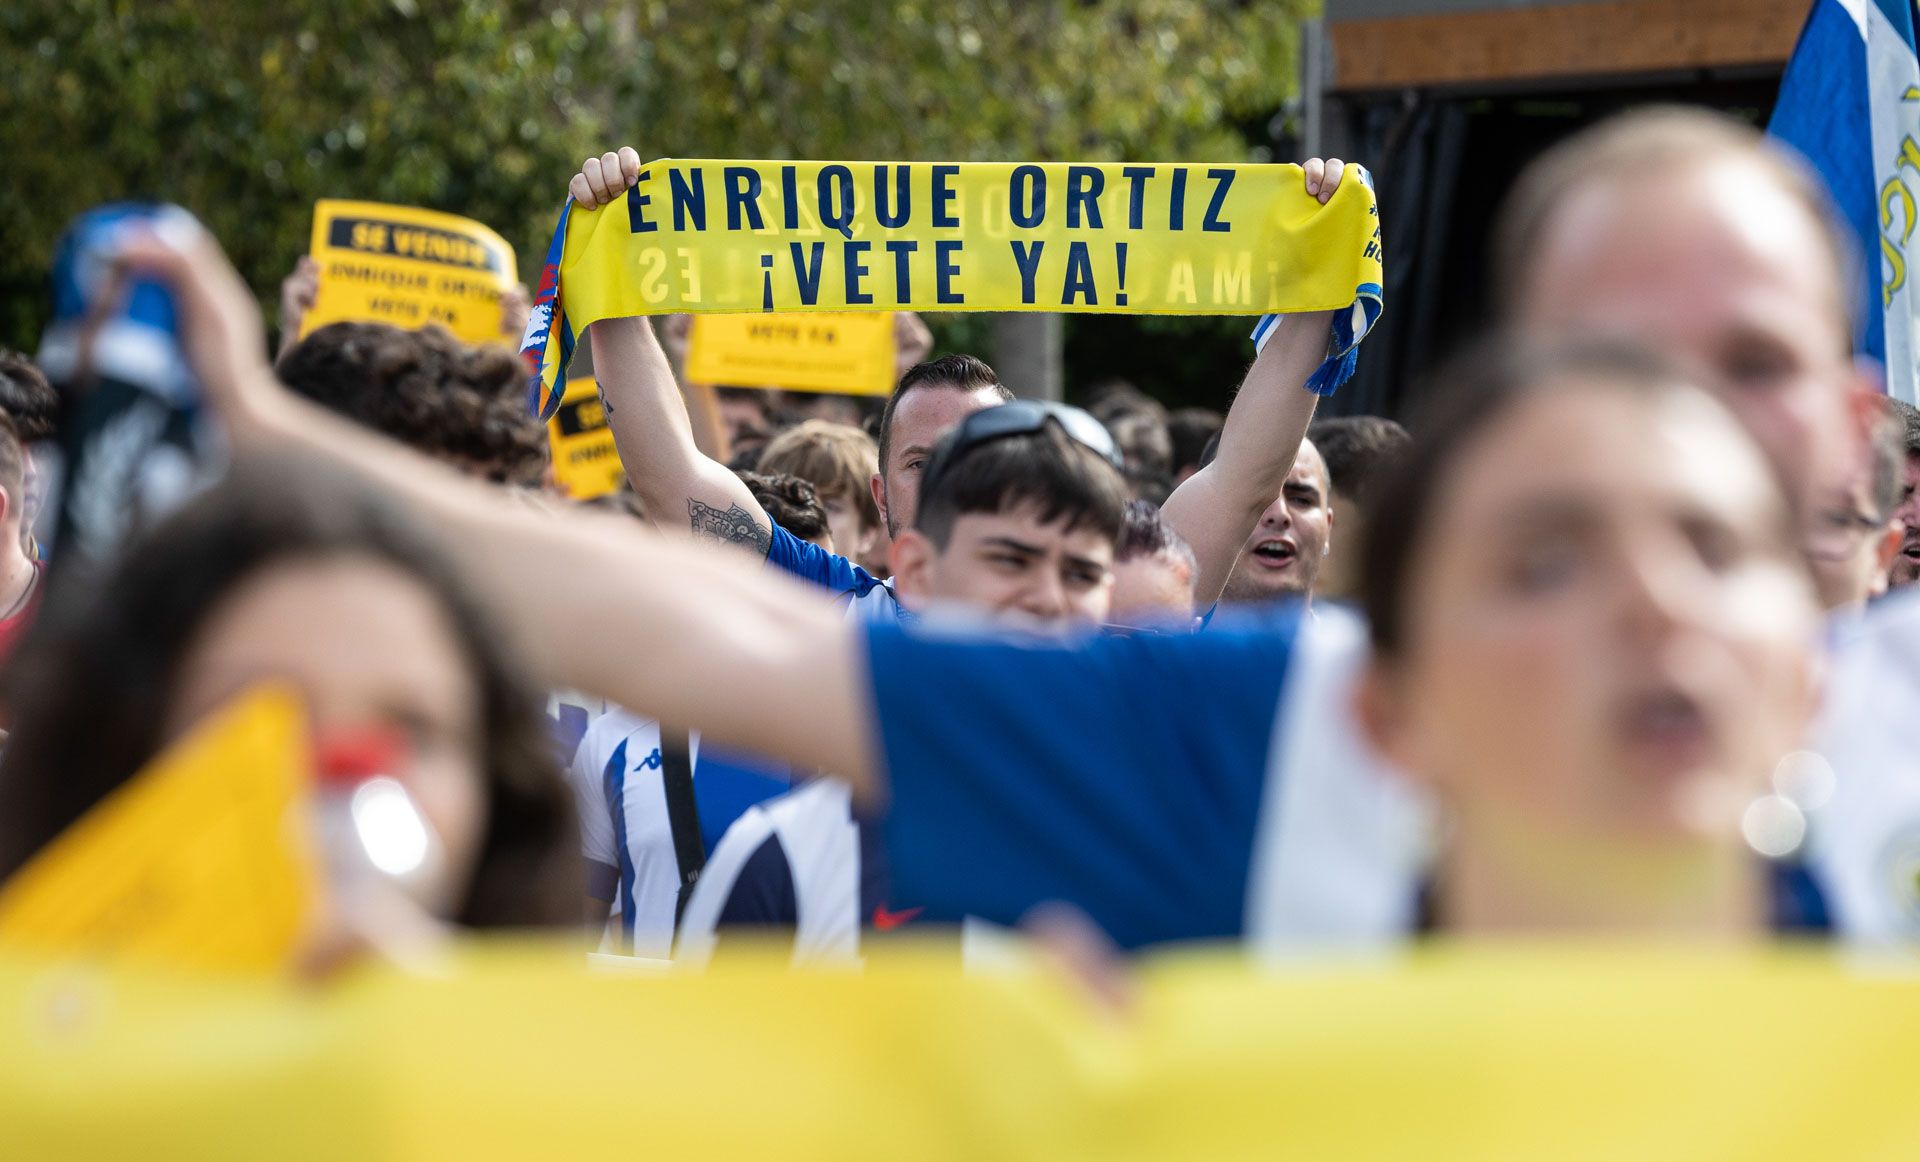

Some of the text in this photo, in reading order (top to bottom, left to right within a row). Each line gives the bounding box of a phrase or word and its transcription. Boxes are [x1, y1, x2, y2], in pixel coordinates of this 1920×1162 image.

[627, 165, 1237, 240] ENRIQUE ORTIZ
[761, 240, 965, 312] ¡VETE
[1009, 240, 1128, 306] YA!
